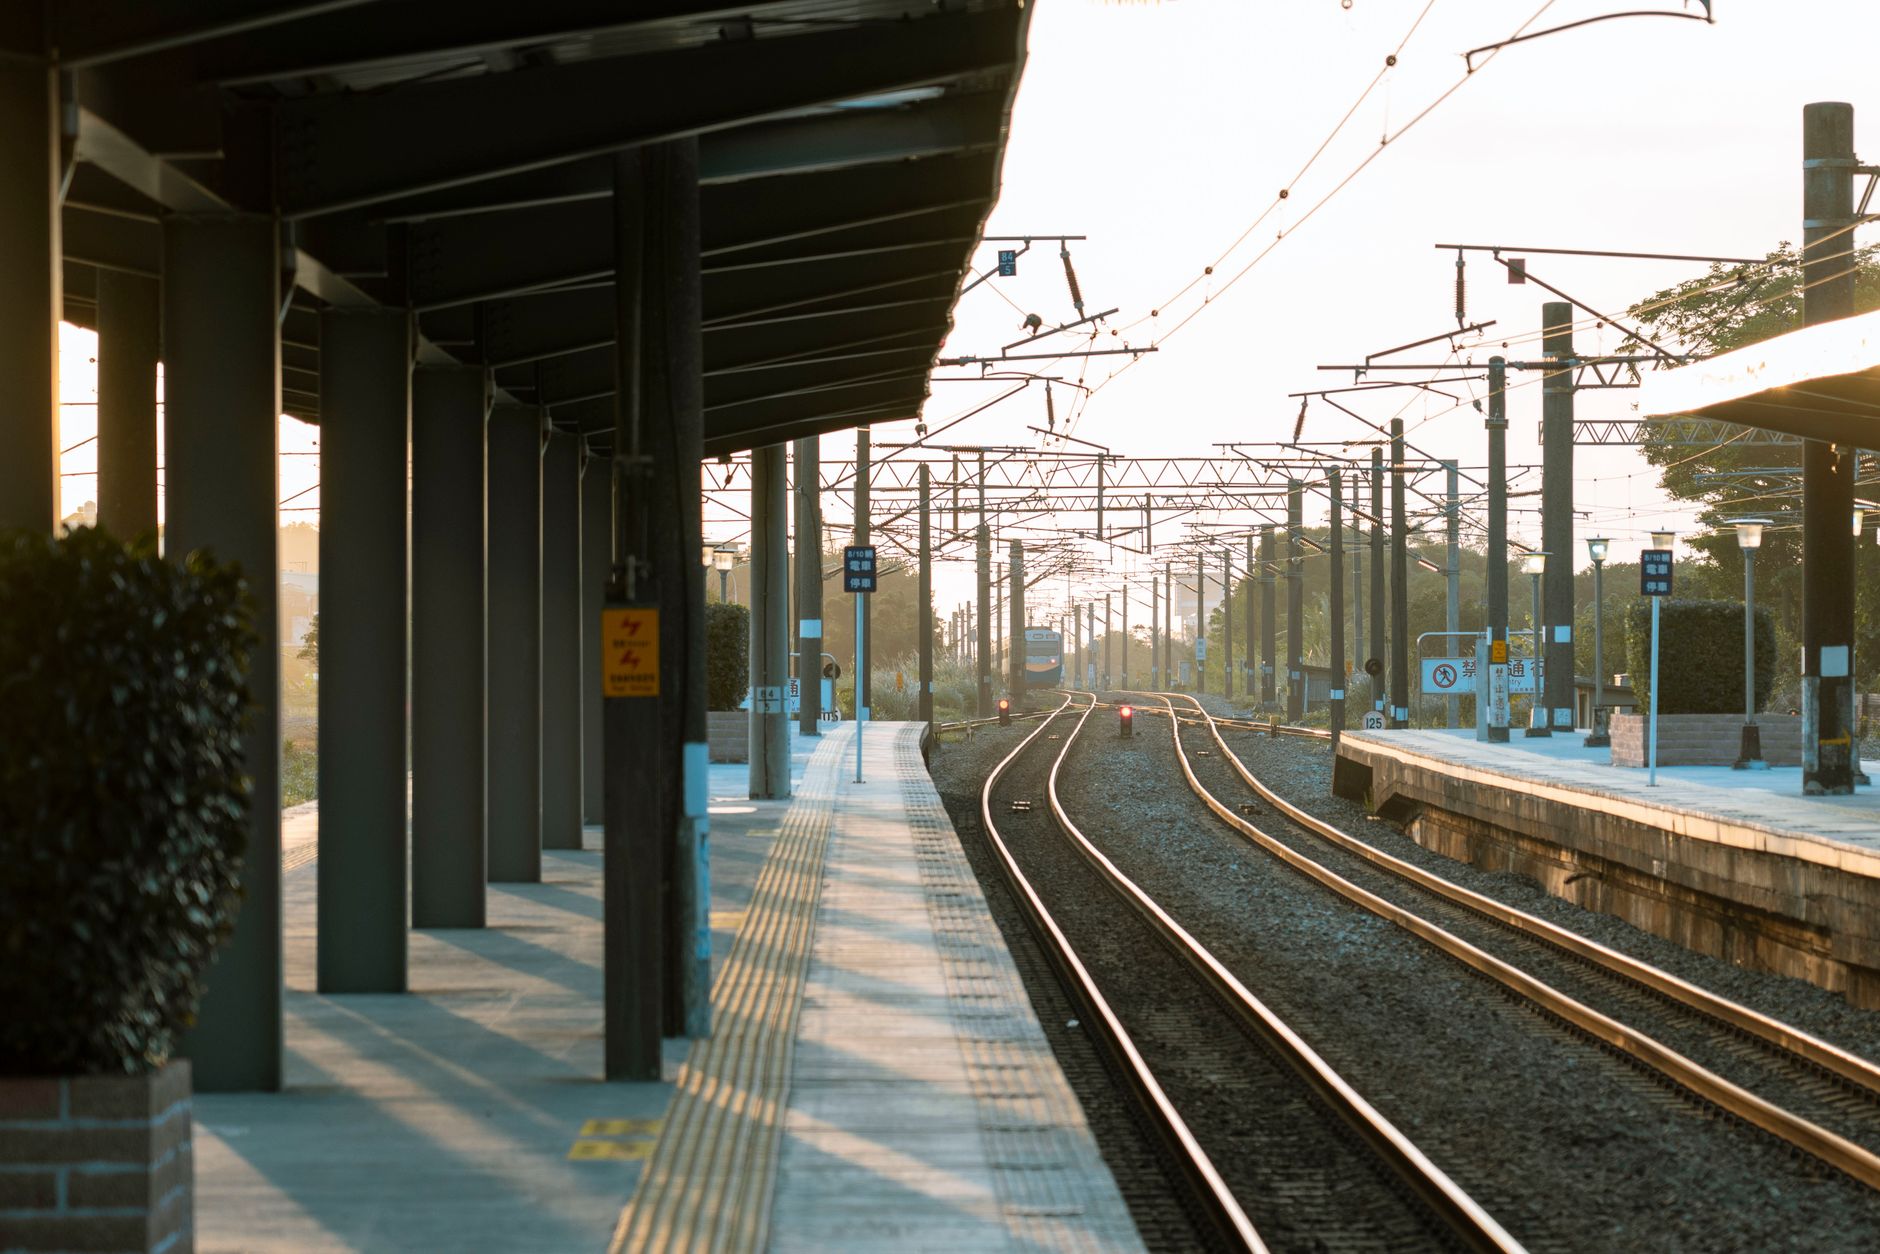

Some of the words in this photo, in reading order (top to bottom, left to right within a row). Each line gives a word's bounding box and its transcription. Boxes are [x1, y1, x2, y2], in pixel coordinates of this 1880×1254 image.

[1001, 252, 1013, 262] 84
[1005, 265, 1011, 274] 5
[1462, 659, 1545, 678] 禁通行
[1366, 718, 1383, 729] 125
